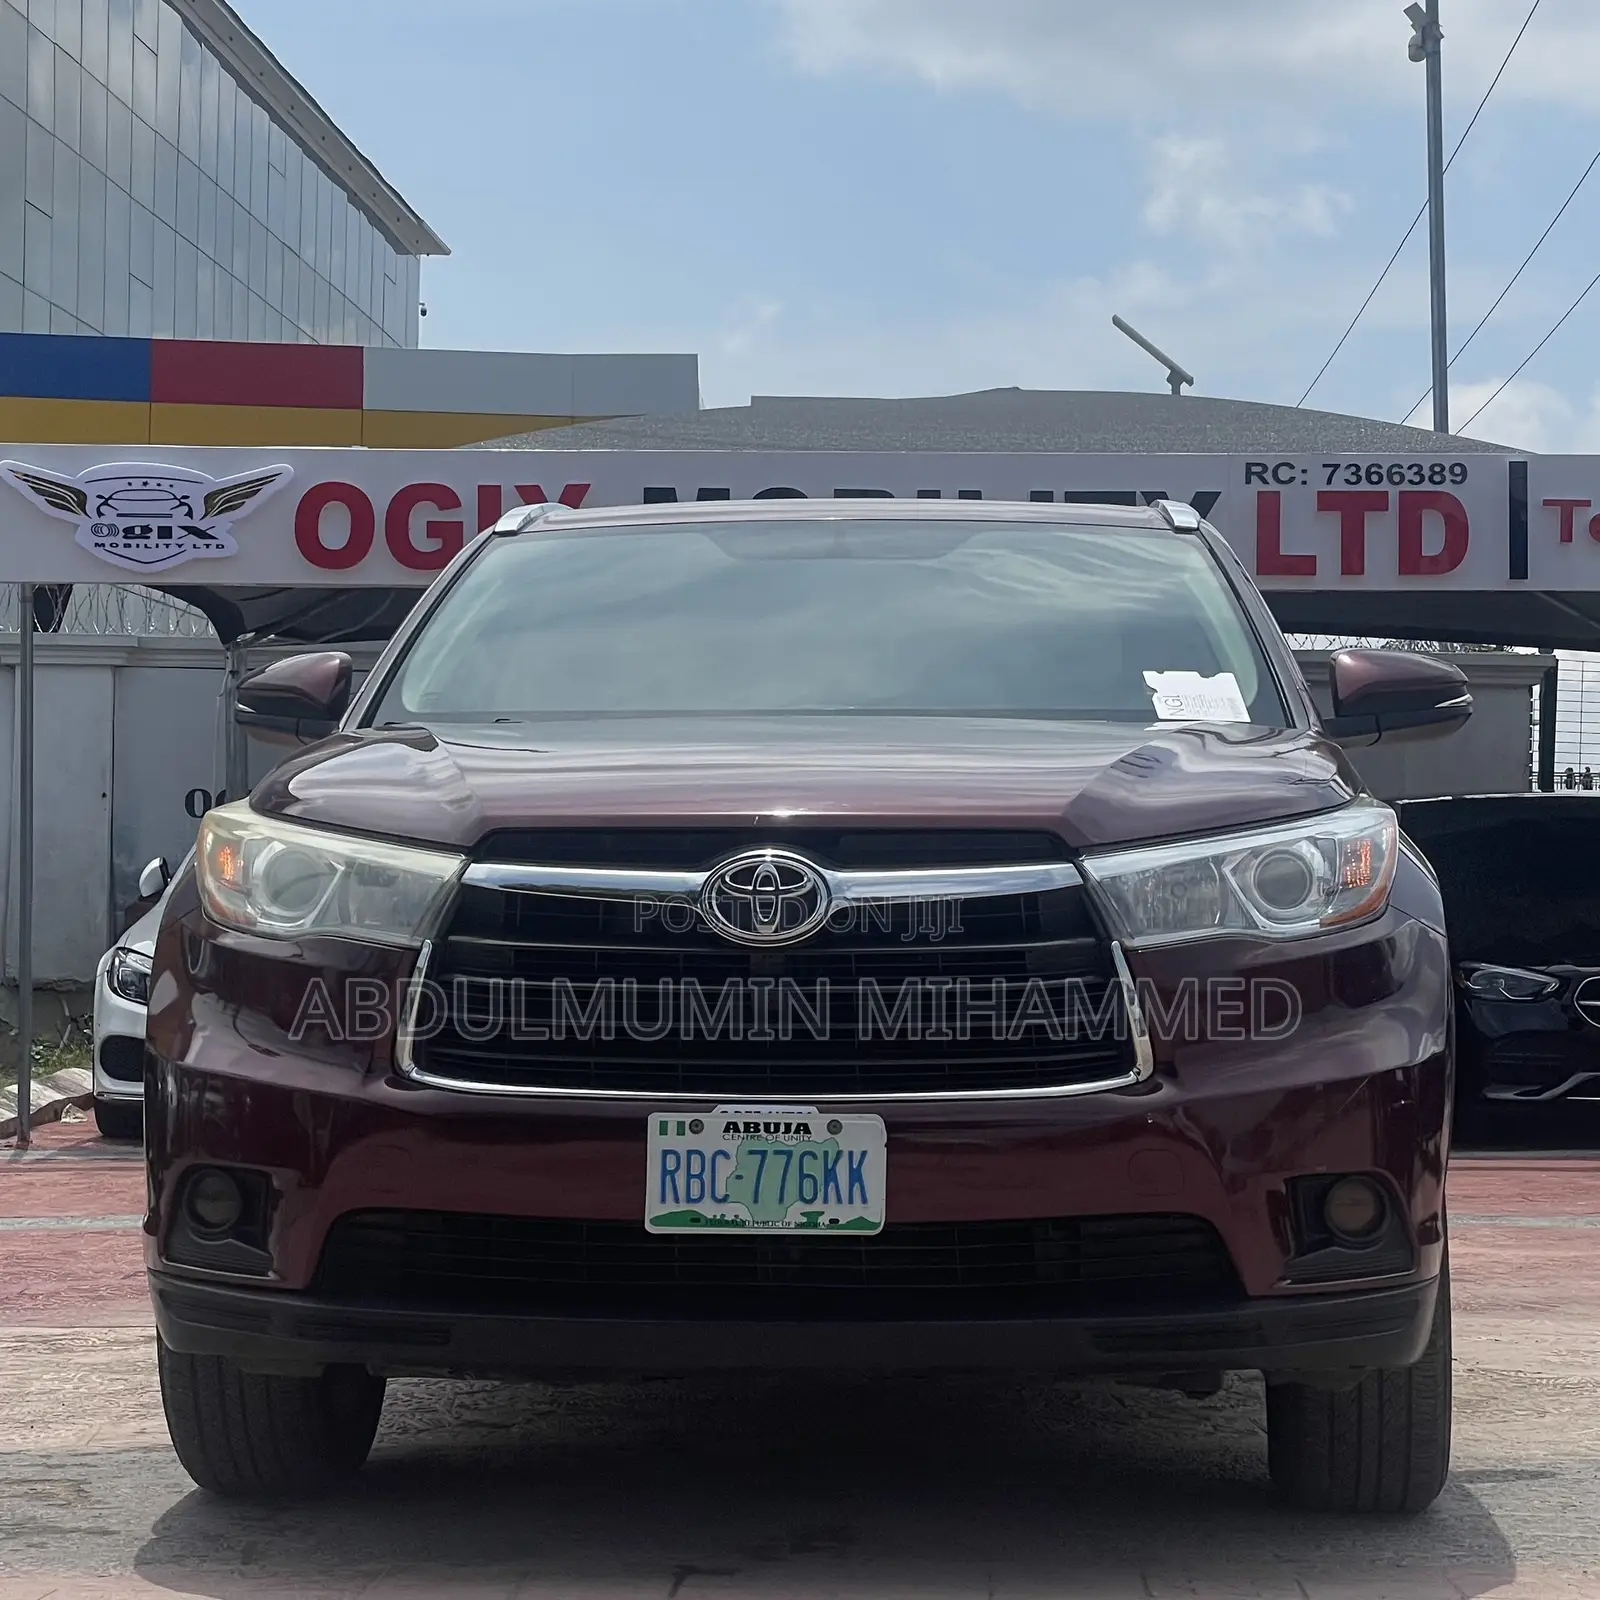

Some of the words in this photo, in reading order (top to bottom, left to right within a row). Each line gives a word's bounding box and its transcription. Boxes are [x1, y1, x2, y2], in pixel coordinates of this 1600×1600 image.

[1244, 462, 1308, 485] RC:
[1322, 462, 1468, 485] 7366389
[294, 481, 592, 571] OGI
[1256, 490, 1469, 576] LTD
[1542, 498, 1600, 543] T
[93, 541, 186, 550] MOBILITY
[722, 1121, 813, 1135] ABUJA
[722, 1133, 761, 1142] CENTRE
[765, 1134, 781, 1142] OF
[783, 1134, 813, 1143] UNITY
